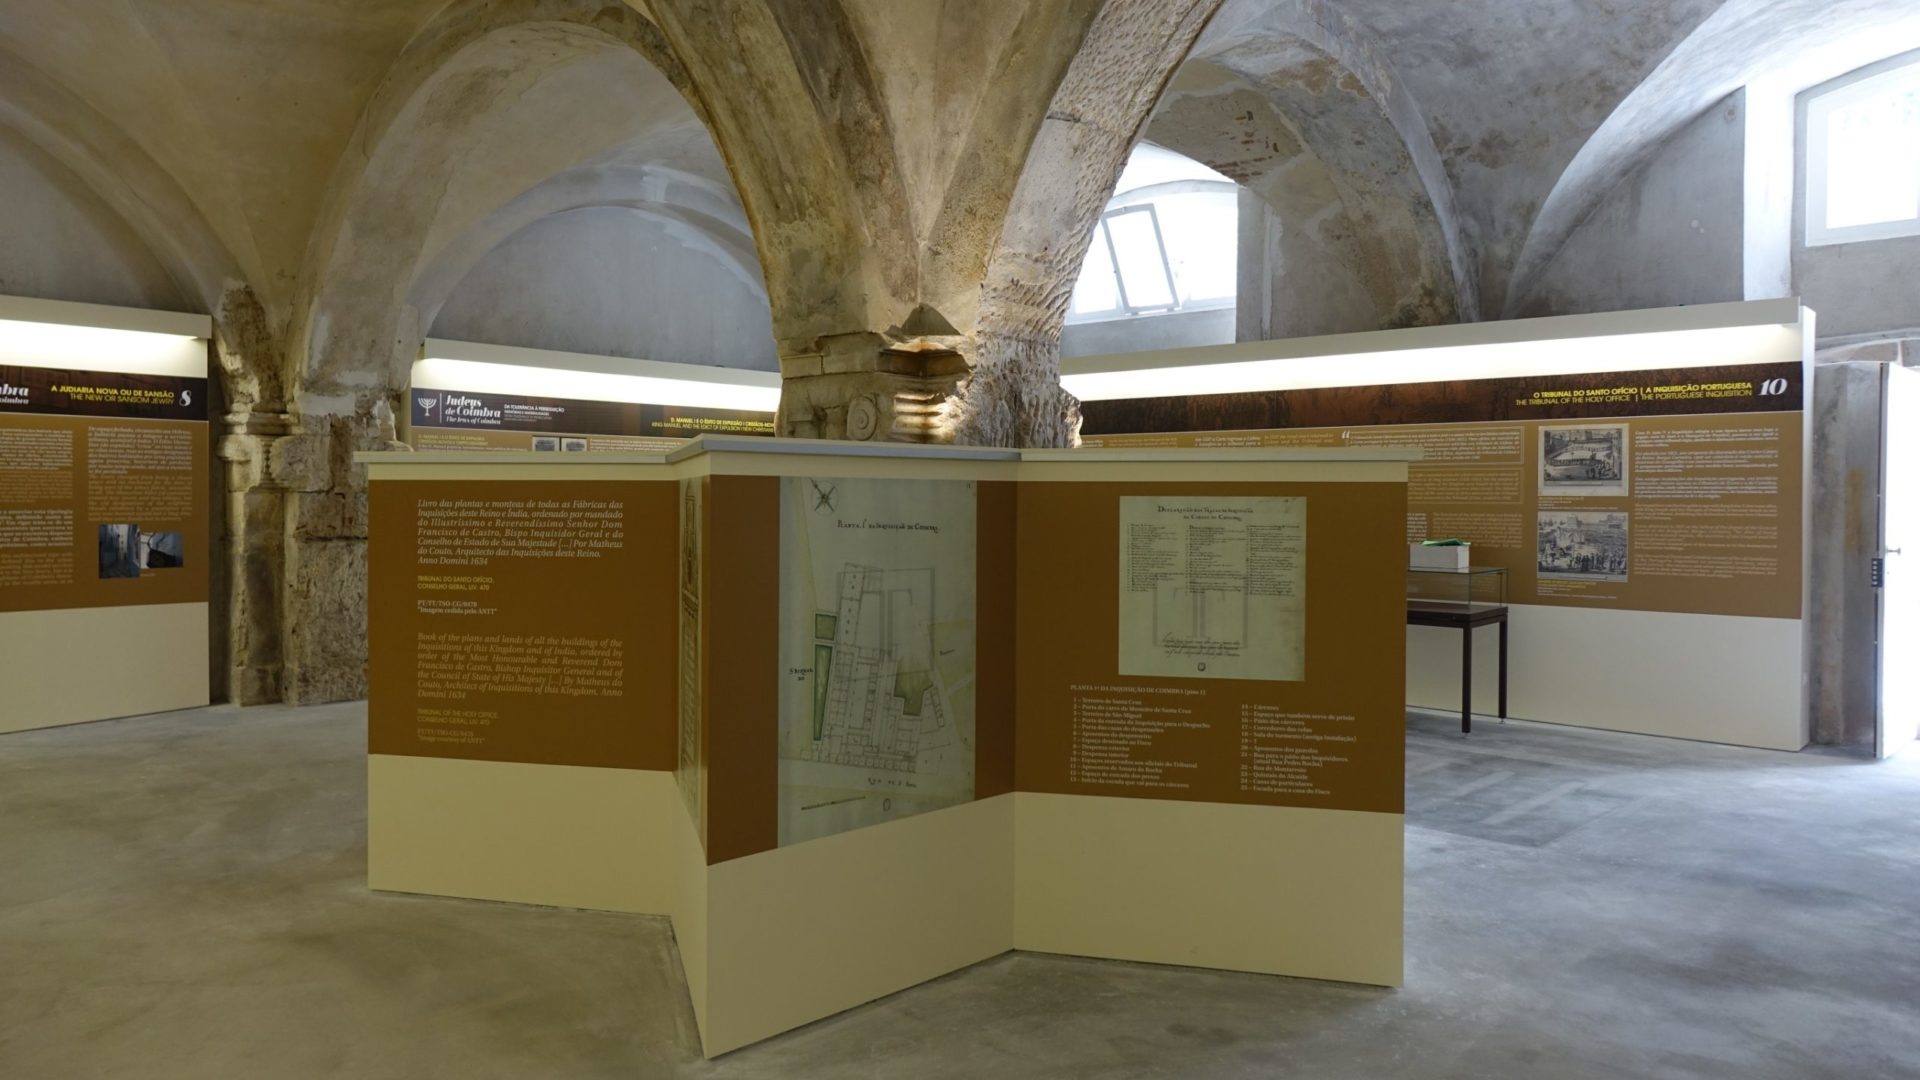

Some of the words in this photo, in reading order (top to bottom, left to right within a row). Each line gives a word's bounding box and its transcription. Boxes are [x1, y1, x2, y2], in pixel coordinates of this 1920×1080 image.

[1611, 387, 1638, 395] OFÍCIO
[1653, 384, 1699, 393] INQUISIÇÃO
[1701, 382, 1752, 391] PORTUGUESA
[1758, 378, 1788, 396] 10
[179, 390, 191, 406] 8
[446, 394, 482, 407] Judeus
[1655, 391, 1703, 400] PORTUGUESE
[1706, 389, 1753, 398] INQUISITION
[445, 407, 456, 415] de
[456, 406, 501, 418] Coimbra
[417, 499, 438, 508] Livro
[439, 500, 453, 508] das
[454, 500, 484, 510] plantas
[491, 500, 525, 508] monteas
[526, 500, 536, 508] de
[537, 500, 560, 508] todas
[572, 500, 607, 508] Fábricas
[608, 500, 624, 508] das
[417, 509, 458, 520] Inquisições
[459, 509, 478, 518] deste
[479, 509, 501, 518] Reino
[507, 509, 529, 519] Índia,
[531, 510, 568, 518] ordenado
[569, 512, 583, 521] por
[584, 510, 624, 519] mandado
[417, 518, 428, 527] do
[495, 519, 564, 528] Reverendíssimo
[566, 519, 598, 528] Senhor
[601, 520, 624, 528] Dom
[417, 528, 458, 536] Francisco
[460, 528, 470, 536] de
[472, 528, 502, 538] Castro,
[504, 528, 528, 539] Bispo
[530, 528, 576, 540] Inquisidor
[578, 529, 603, 538] Geral
[612, 529, 624, 538] do
[417, 537, 452, 546] Conselho
[453, 538, 462, 546] de
[463, 538, 490, 546] Estado
[490, 538, 500, 546] de
[501, 538, 516, 547] Sua
[517, 538, 557, 549] Majestade
[573, 539, 587, 547] Por
[588, 539, 624, 548] Matheus
[417, 547, 428, 555] do
[455, 547, 494, 558] Arquitecto
[495, 548, 510, 556] das
[511, 548, 554, 559] Inquisições
[555, 548, 575, 557] deste
[576, 549, 602, 557] Reino.
[417, 556, 438, 565] Anno
[439, 557, 469, 565] Domini
[470, 557, 489, 565] 1634
